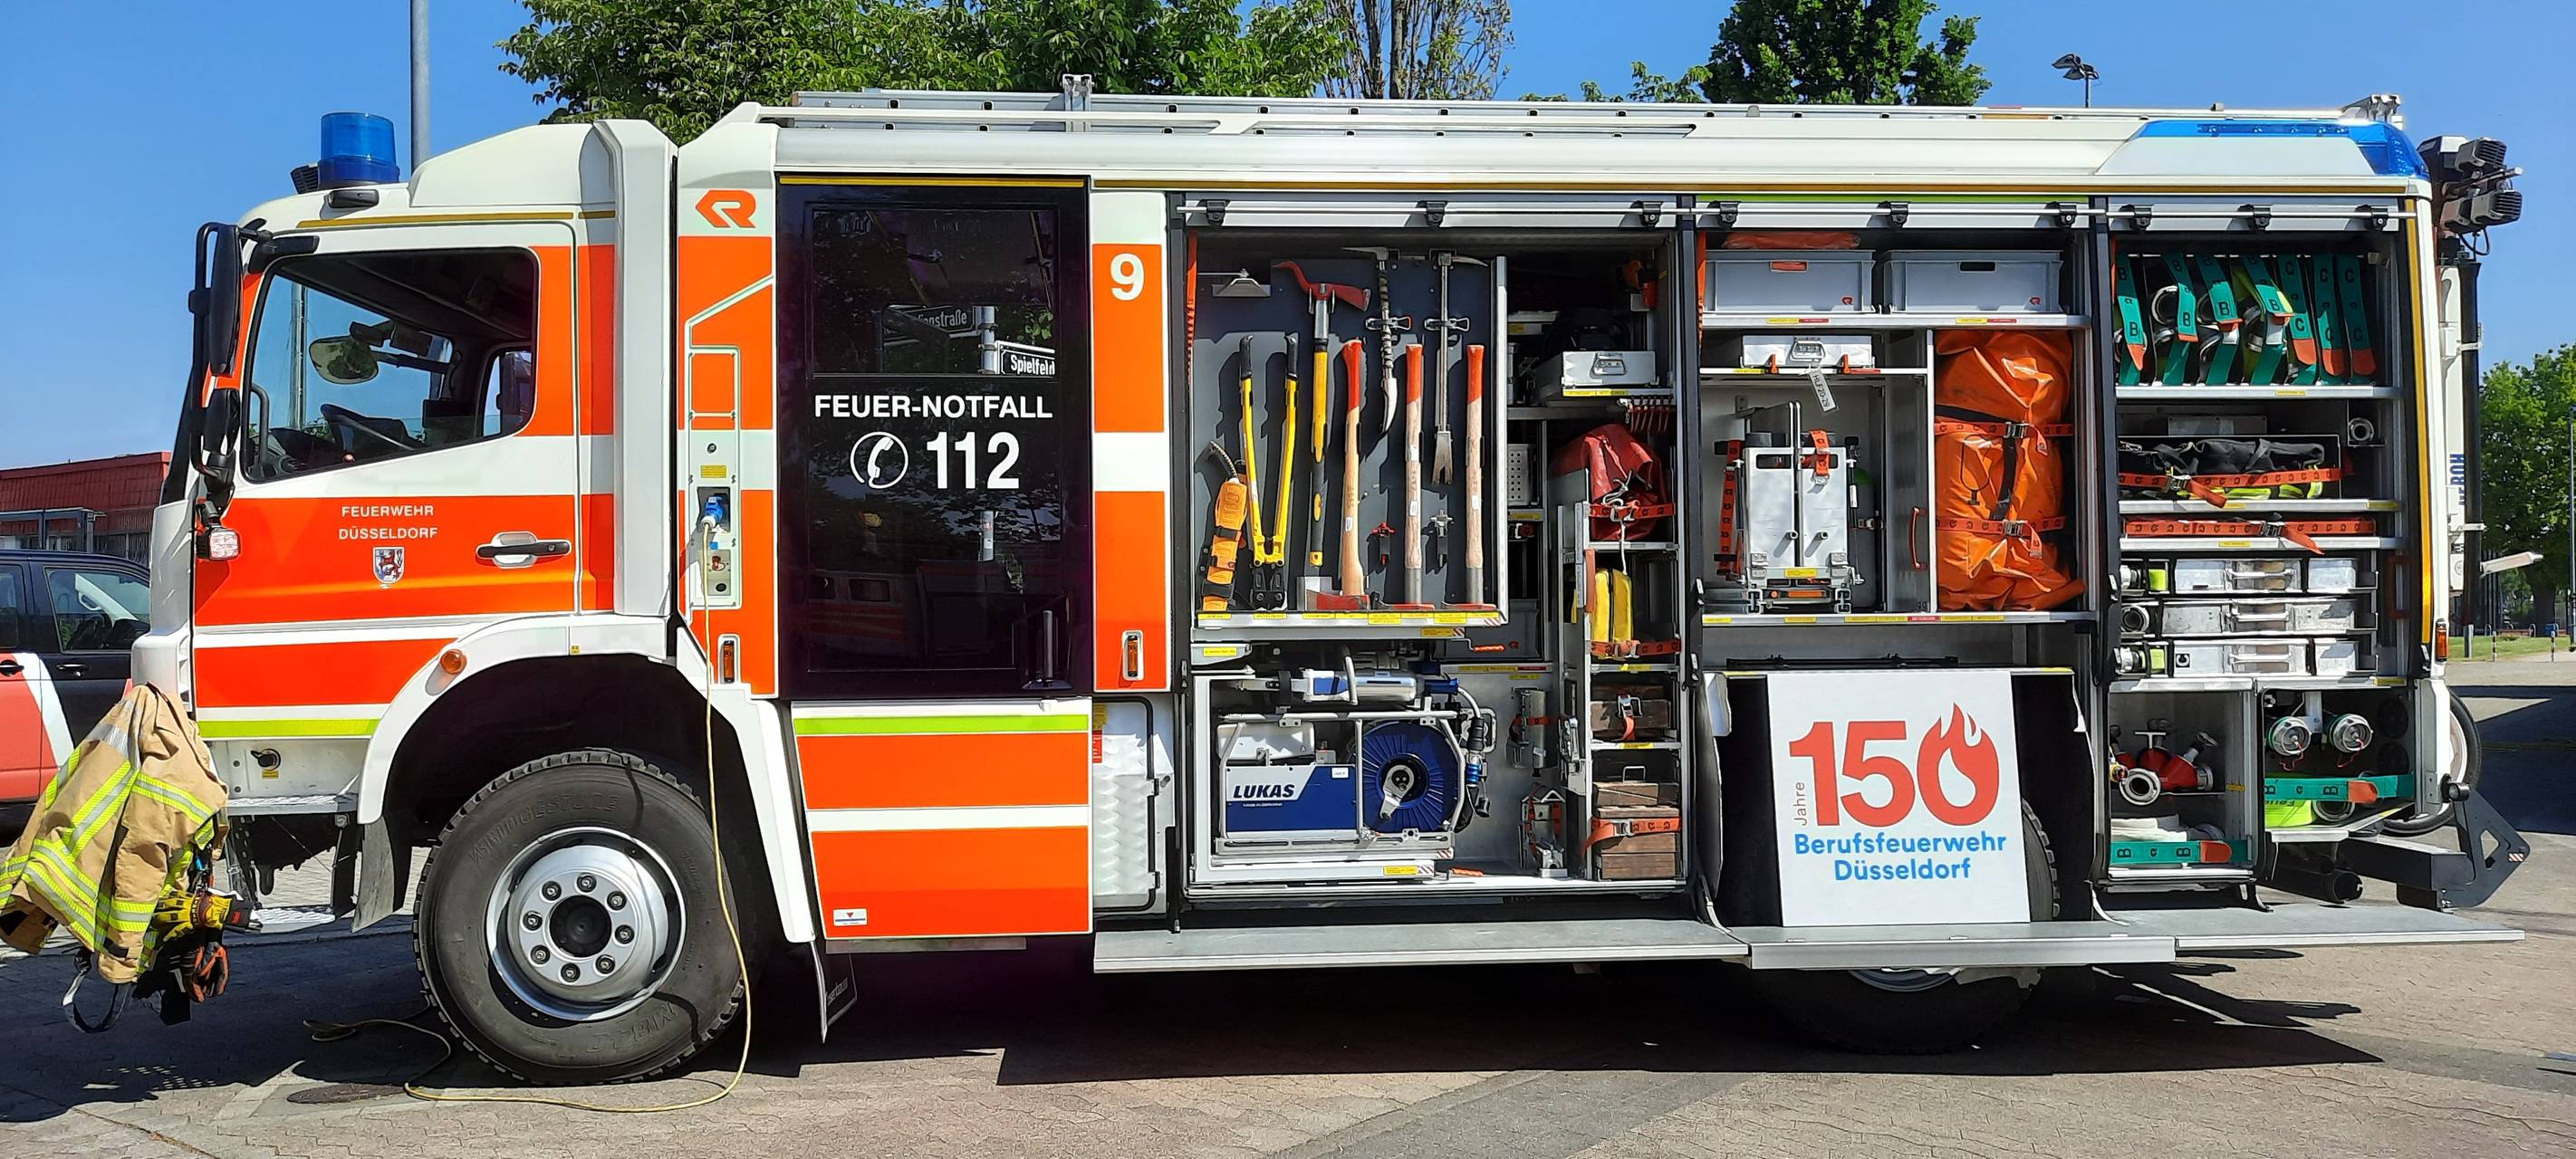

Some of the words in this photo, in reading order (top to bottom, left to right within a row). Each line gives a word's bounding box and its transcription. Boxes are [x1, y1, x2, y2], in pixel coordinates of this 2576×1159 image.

[1110, 253, 1145, 301] 9
[2218, 302, 2230, 316] B
[2268, 299, 2280, 311] B
[2183, 311, 2191, 327] B
[2295, 318, 2305, 331] C
[2129, 321, 2139, 337] B
[1010, 354, 1055, 375] Spielfeld
[814, 395, 1053, 418] FEUER-NOTFALL
[927, 431, 1020, 489] 112
[341, 505, 434, 517] FEUERWEHR
[339, 525, 438, 540] DÜSSELDORF
[1789, 702, 1999, 828] 150
[1233, 784, 1295, 799] LUKAS
[2322, 785, 2339, 796] B
[1793, 781, 1807, 826] Jahre
[1794, 830, 2007, 854] Berufsfeuerwehr
[2117, 848, 2131, 857] B
[2177, 848, 2191, 857] B
[1834, 857, 1971, 881] Düsseldorf
